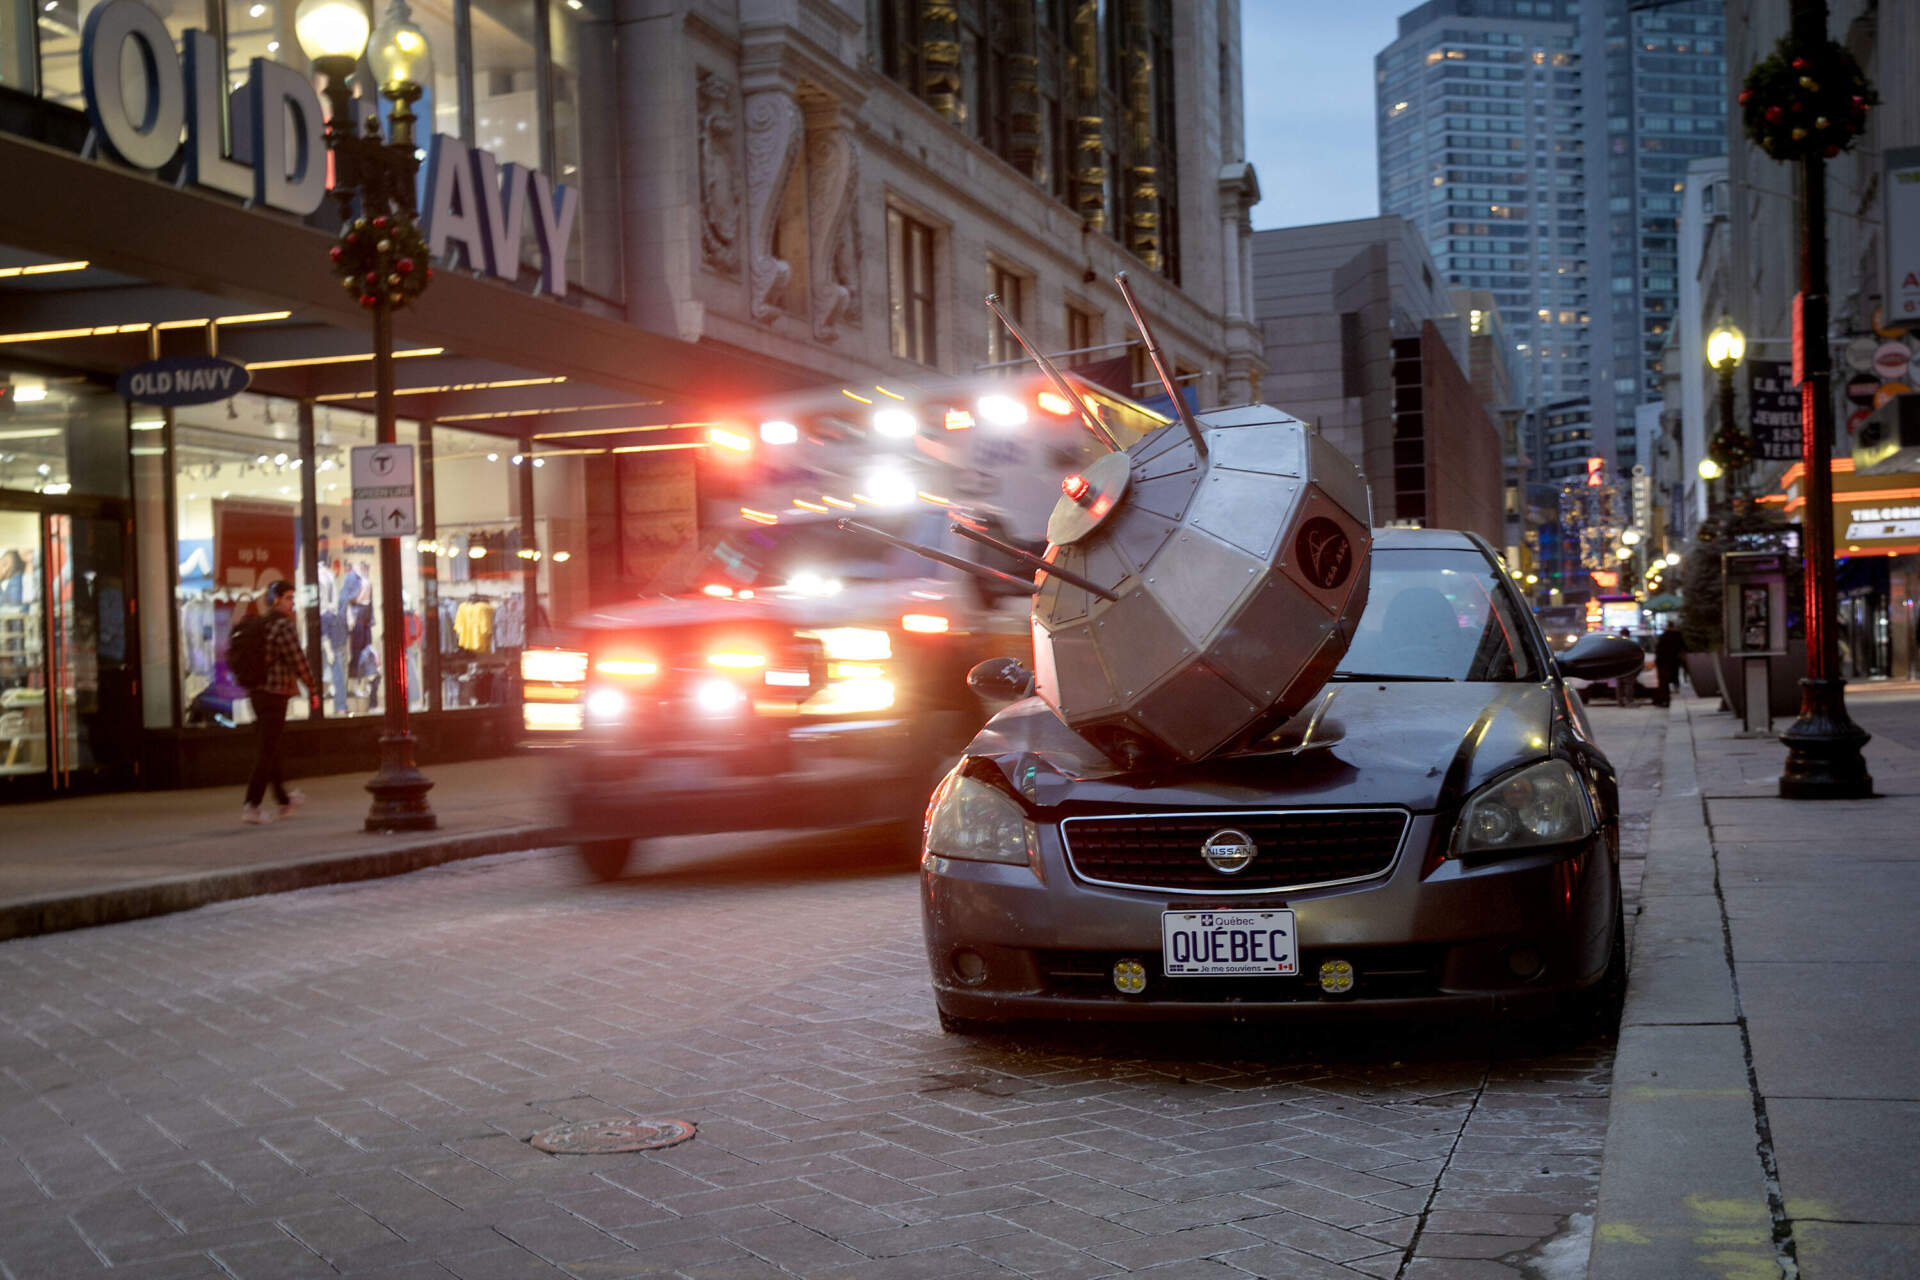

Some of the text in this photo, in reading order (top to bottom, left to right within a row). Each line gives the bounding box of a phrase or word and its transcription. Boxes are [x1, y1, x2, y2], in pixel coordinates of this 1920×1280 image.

[81, 1, 327, 215] OLD
[130, 367, 234, 396] OLD NAVY
[1752, 411, 1802, 426] JEWEL
[1763, 443, 1802, 457] YEAR
[238, 546, 269, 564] up to
[1206, 847, 1250, 856] NISSAN
[1215, 916, 1255, 926] Québec
[1172, 927, 1288, 963] QUÉBEC
[1200, 965, 1210, 973] Je
[1226, 965, 1262, 973] souviens
